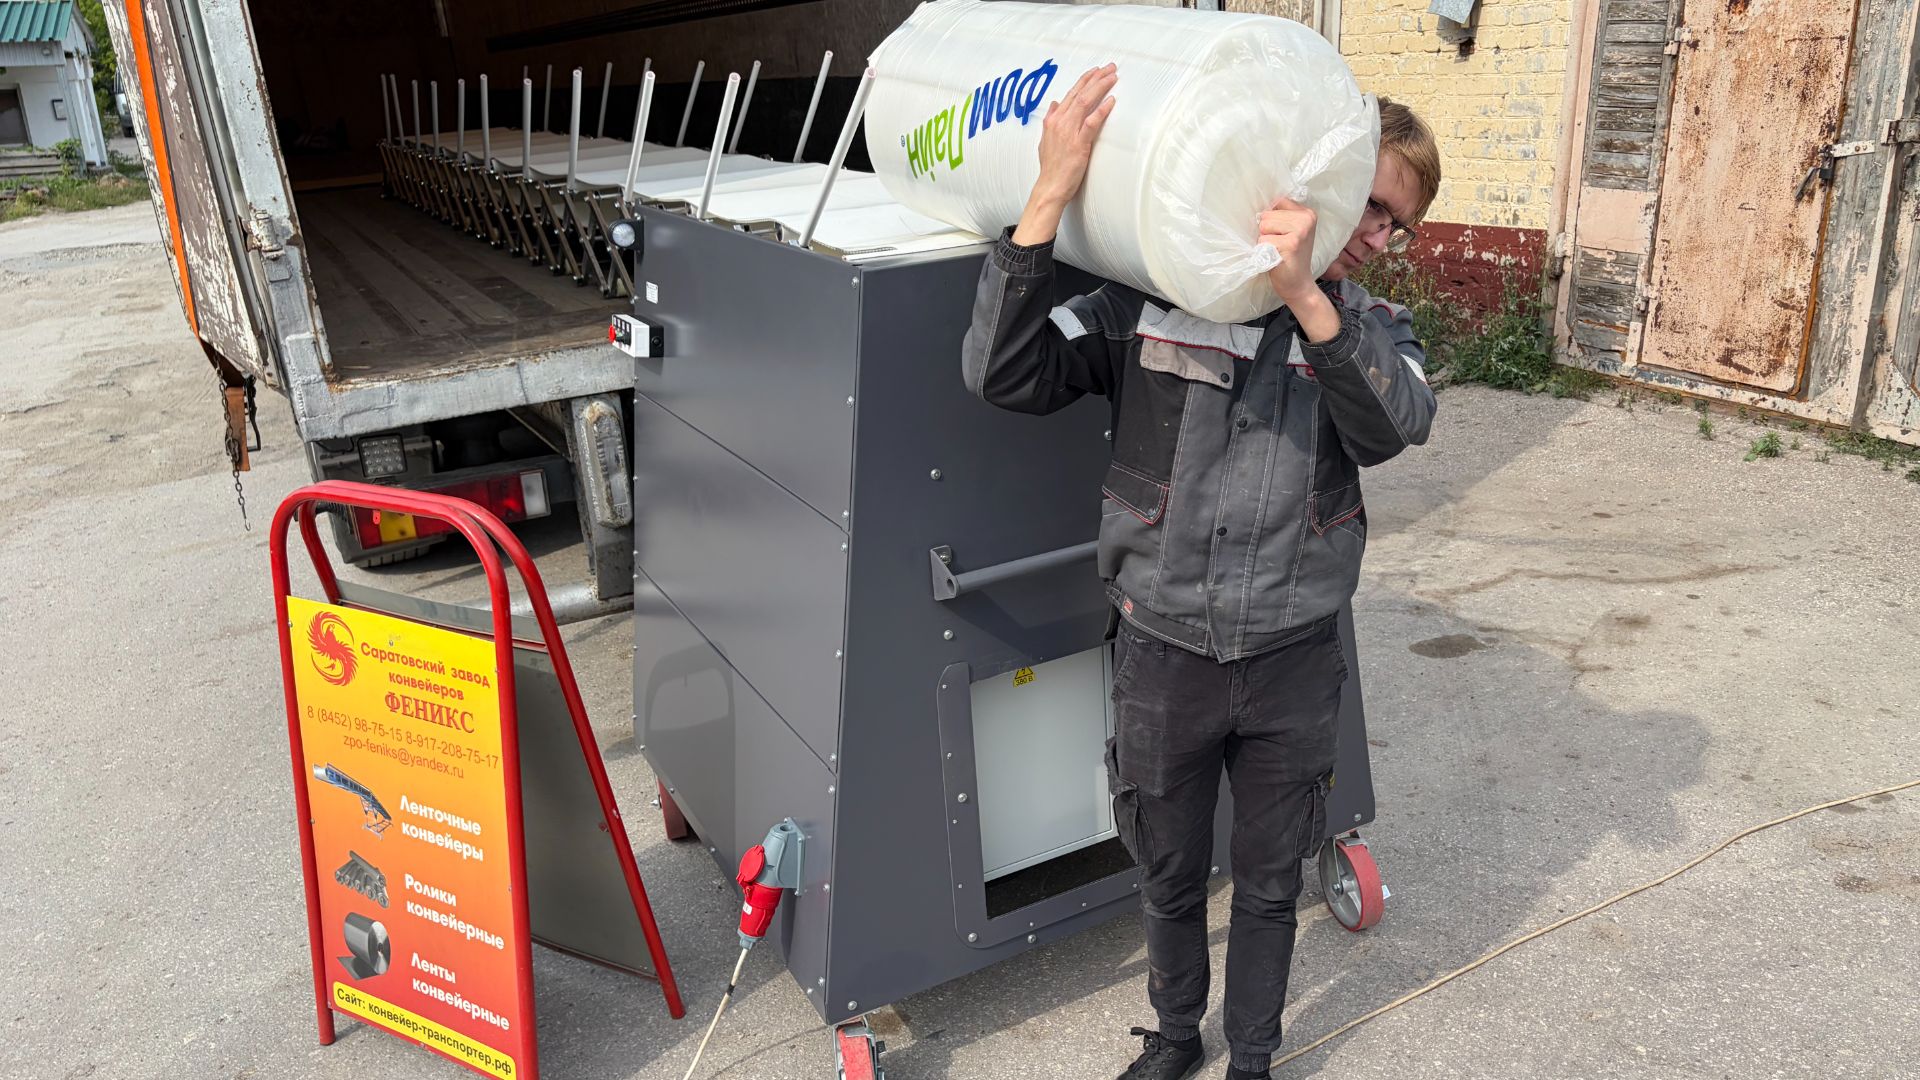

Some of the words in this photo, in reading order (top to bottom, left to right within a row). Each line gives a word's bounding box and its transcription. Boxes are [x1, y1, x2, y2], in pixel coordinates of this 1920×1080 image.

[360, 642, 446, 676] Саратовский
[451, 667, 491, 689] завод
[388, 671, 465, 701] конвейеров
[384, 691, 475, 734] ФЕНИКС
[307, 705, 314, 719] 8
[317, 708, 352, 731] (8452)
[354, 717, 403, 742] 98-75-15
[405, 729, 499, 769] 8-917-208-75-17
[343, 735, 464, 779] zpo-feniks@yandex.ru
[400, 795, 482, 836] Ленточные
[401, 822, 484, 861] конвейеры
[404, 873, 457, 906] Ролики
[406, 901, 505, 950] конвейерные
[411, 952, 456, 984] Ленты
[412, 978, 510, 1031] конвейерные
[337, 988, 366, 1010] Сайт:
[368, 1003, 512, 1077] конвейер-транспортер.рф
